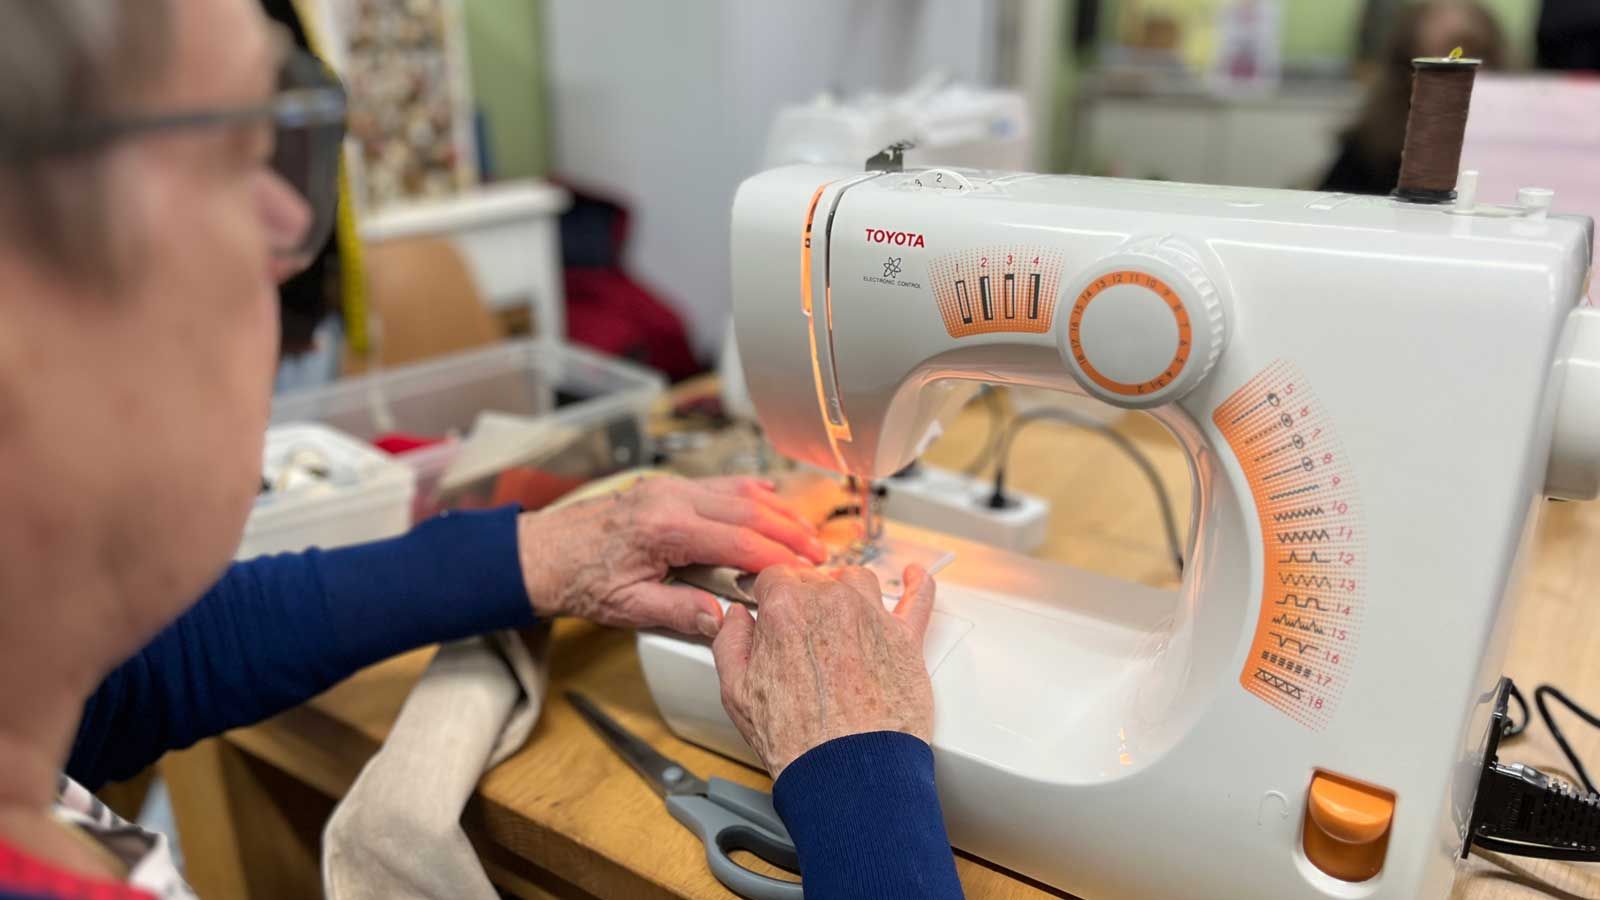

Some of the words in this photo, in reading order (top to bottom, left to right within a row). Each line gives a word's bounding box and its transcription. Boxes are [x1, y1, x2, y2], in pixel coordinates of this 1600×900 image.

[936, 172, 943, 183] 2
[865, 229, 925, 248] TOYOTA
[981, 257, 988, 267] 2
[1006, 255, 1013, 265] 3
[1033, 256, 1040, 265] 4
[863, 276, 895, 286] ELECTRONIC
[897, 280, 921, 289] CONTROL
[1284, 383, 1295, 395] 5
[1300, 406, 1309, 417] 6
[1311, 428, 1322, 440] 7
[1323, 453, 1333, 464] 8
[1332, 500, 1348, 514] 10
[1339, 526, 1353, 540] 11
[1338, 551, 1355, 565] 12
[1339, 578, 1356, 592] 13
[1336, 602, 1351, 615] 14
[1332, 627, 1347, 641] 15
[1325, 650, 1340, 665] 16
[1316, 672, 1332, 687] 17
[1308, 695, 1323, 709] 18
